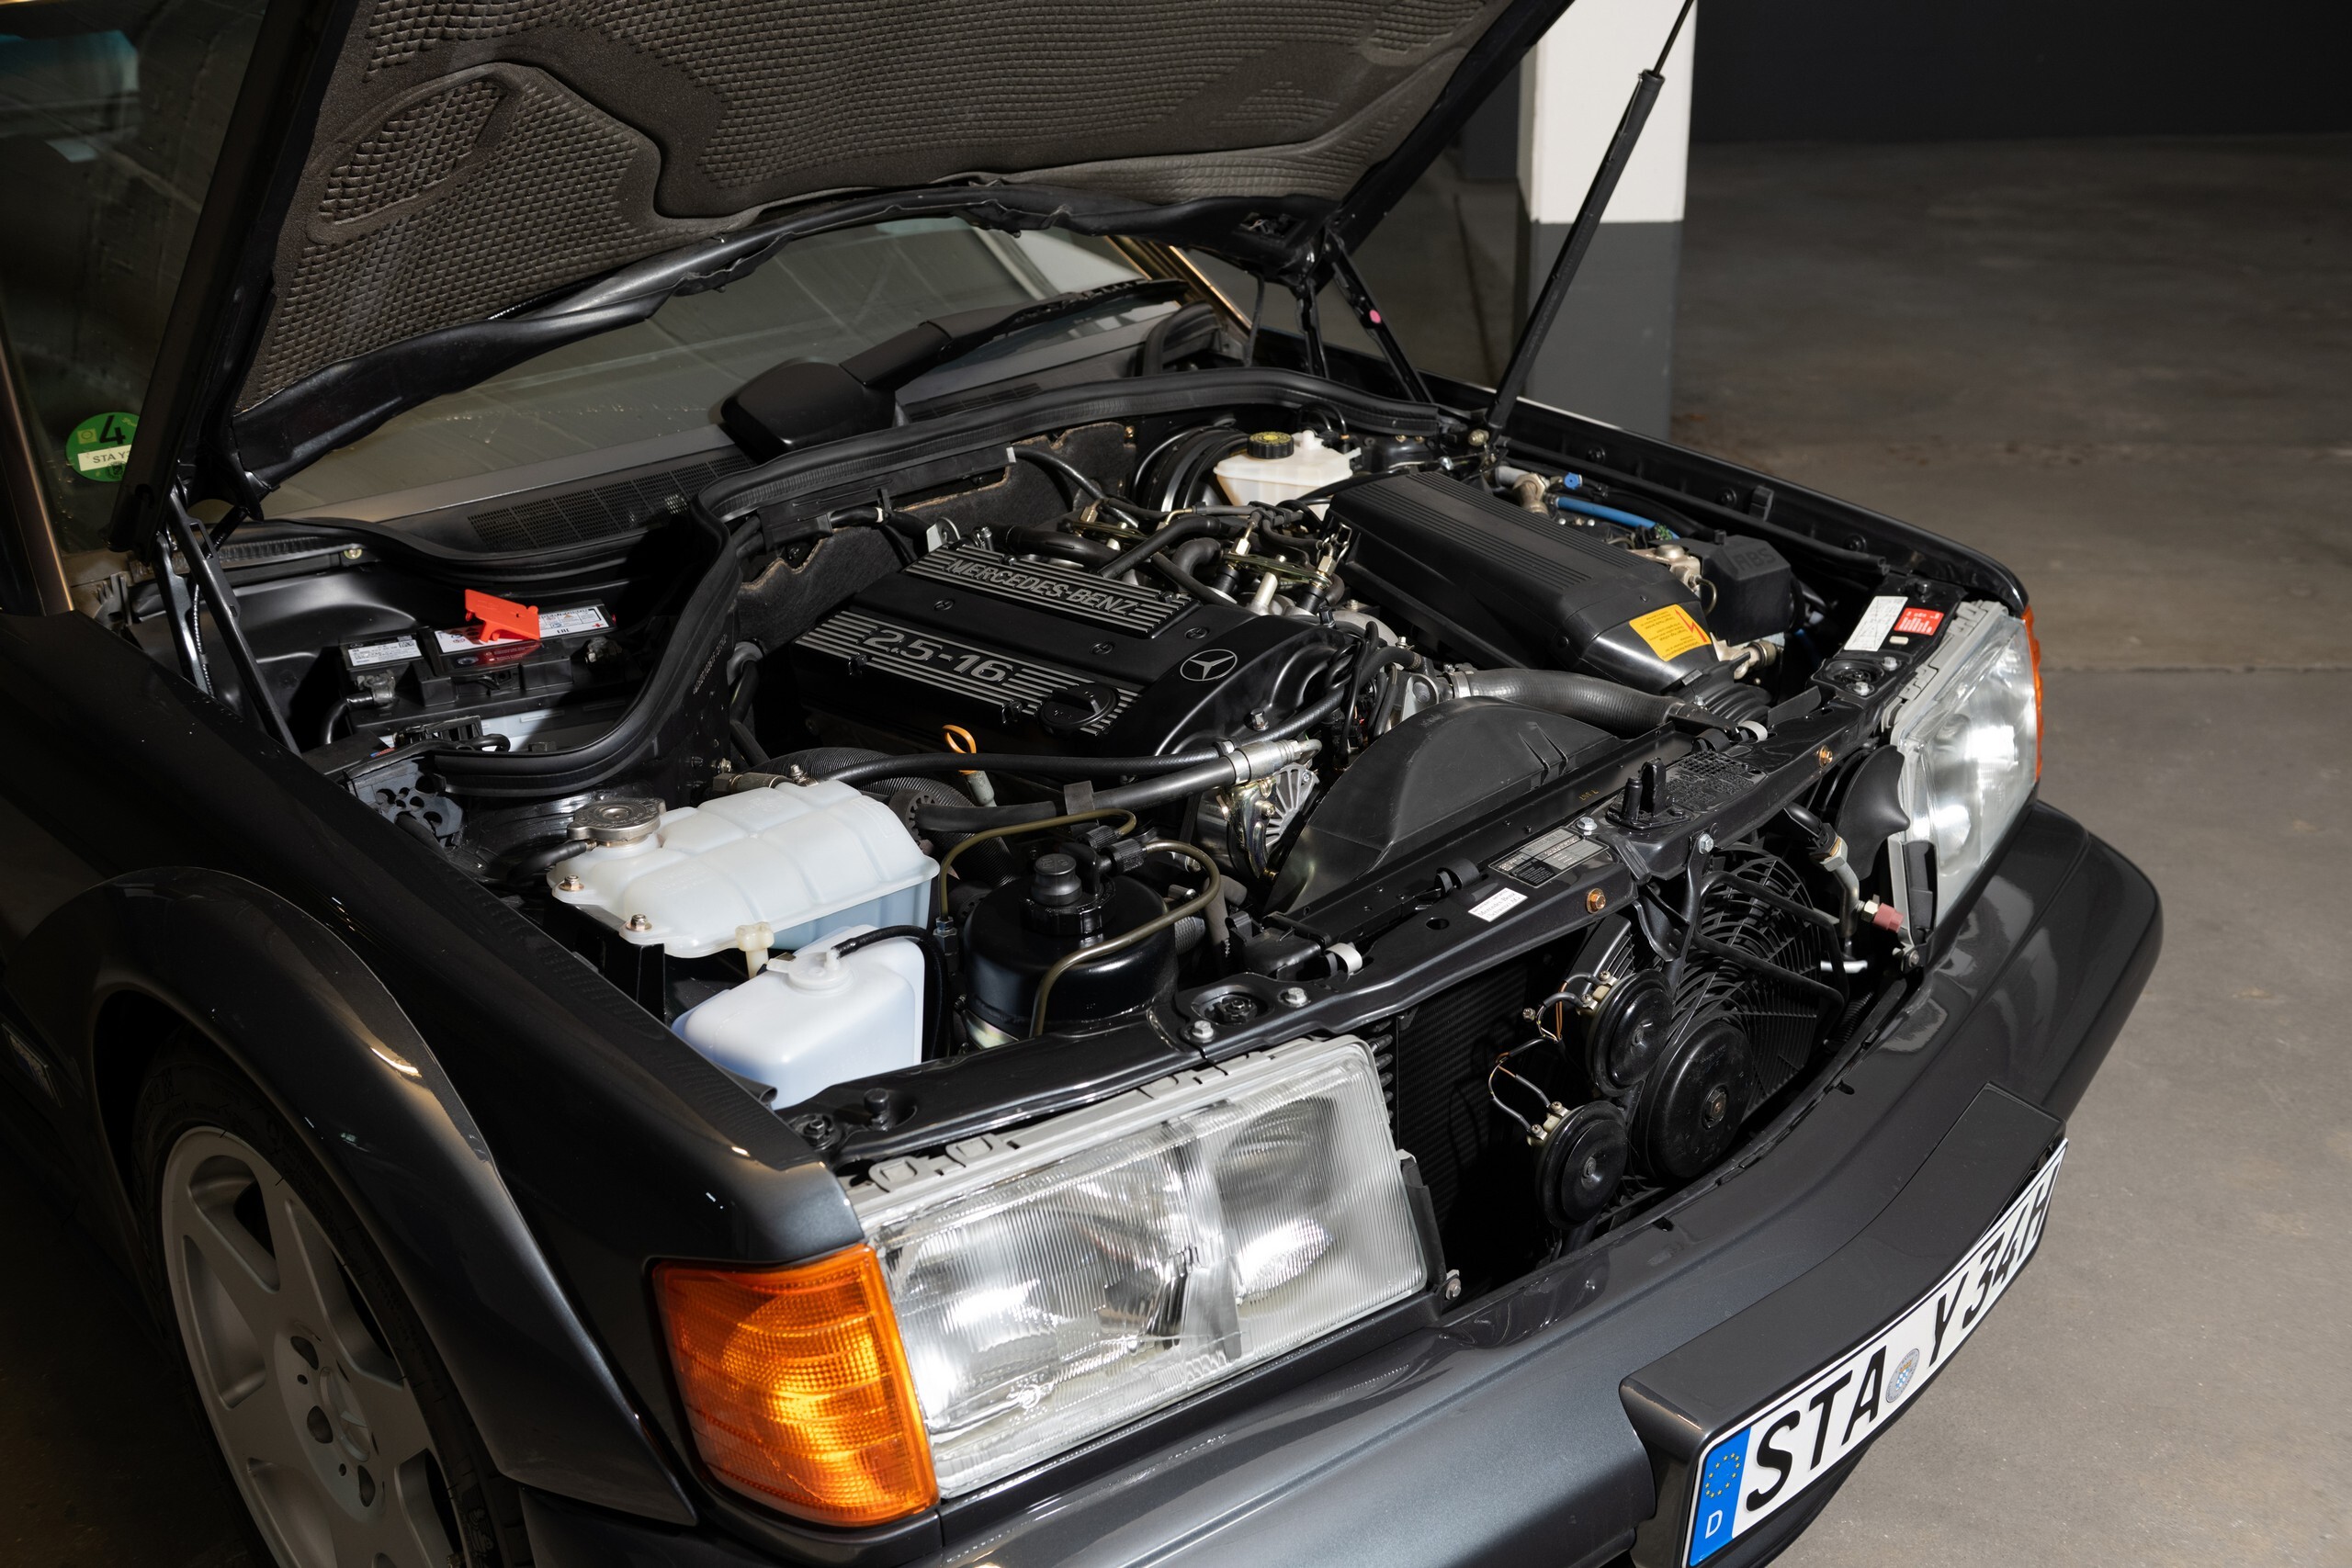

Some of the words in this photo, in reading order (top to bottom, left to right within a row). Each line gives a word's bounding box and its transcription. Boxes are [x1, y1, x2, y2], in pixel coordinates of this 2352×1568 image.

[99, 414, 126, 445] 4
[93, 453, 116, 464] STA
[1733, 547, 1776, 570] ABS
[946, 558, 1139, 615] MERCEDES-BENZ
[863, 629, 1013, 682] 2.5-16
[1746, 1345, 1886, 1512] STA
[1928, 1270, 1970, 1369] Y
[1705, 1510, 1724, 1540] D
